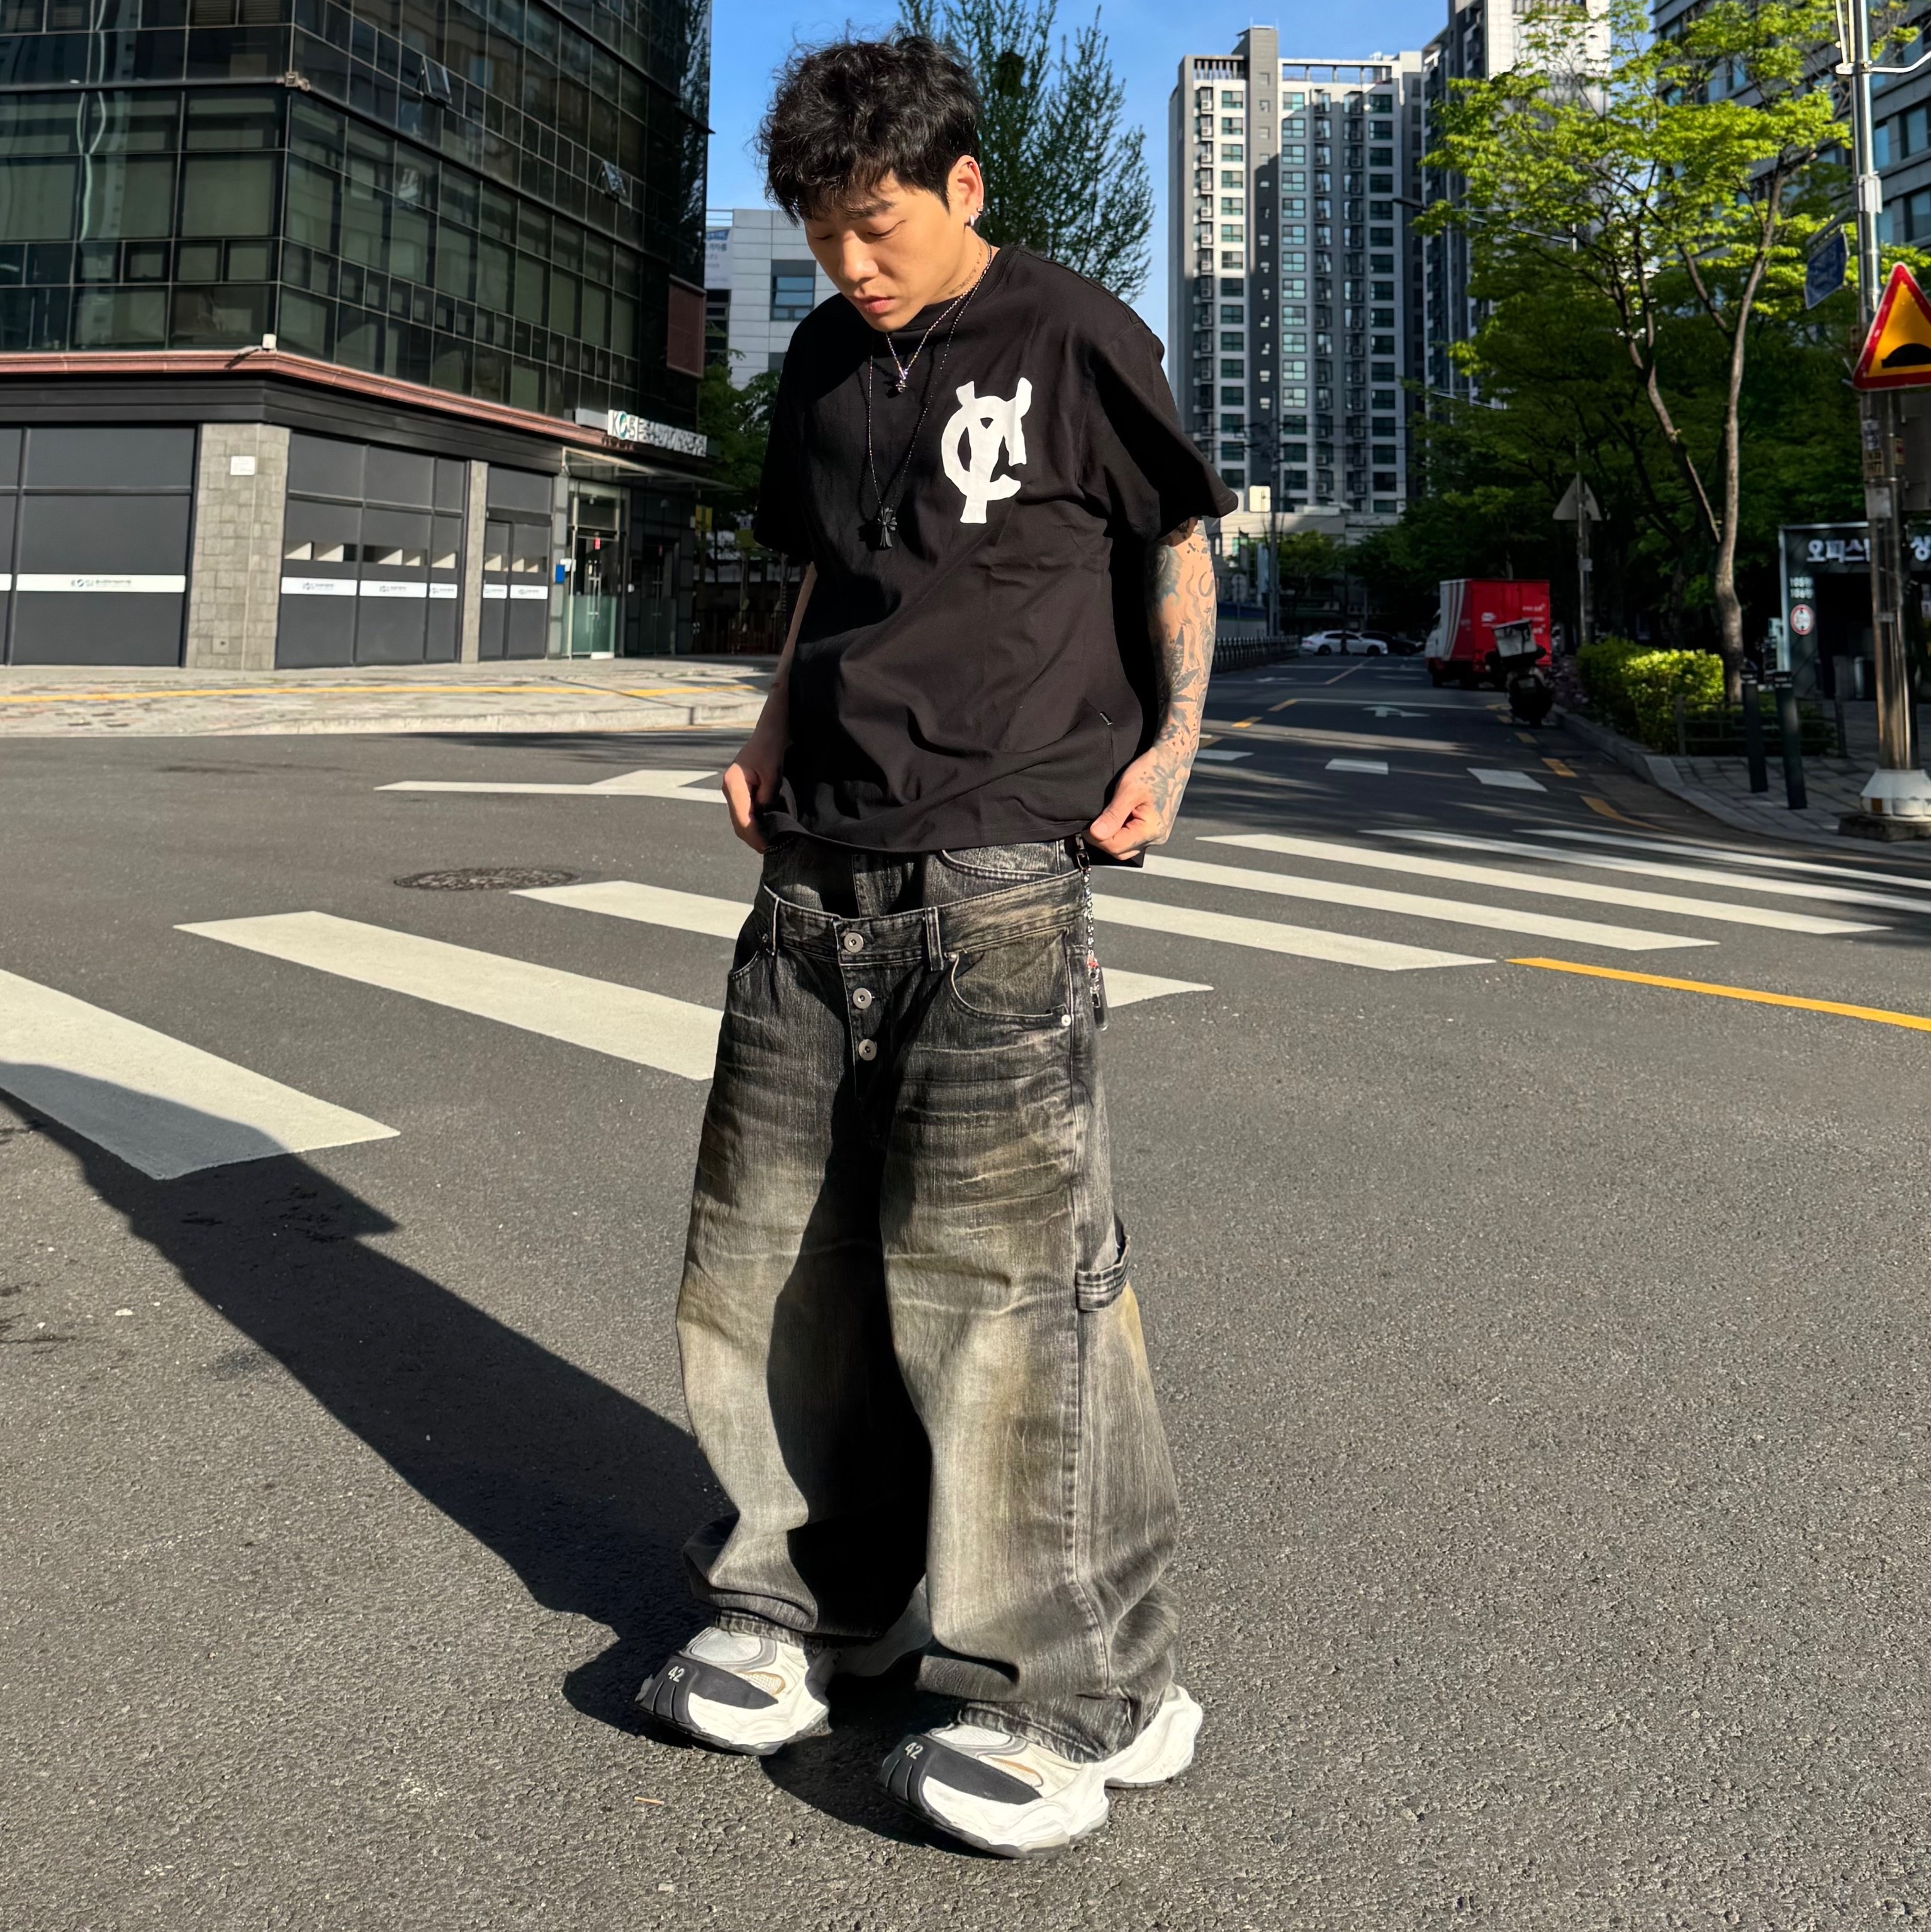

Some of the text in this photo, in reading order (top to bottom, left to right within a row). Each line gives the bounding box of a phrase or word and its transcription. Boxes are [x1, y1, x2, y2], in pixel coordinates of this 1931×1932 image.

[1806, 539, 1870, 563] 오피스
[668, 1665, 685, 1683] 42
[905, 1742, 924, 1760] 42
